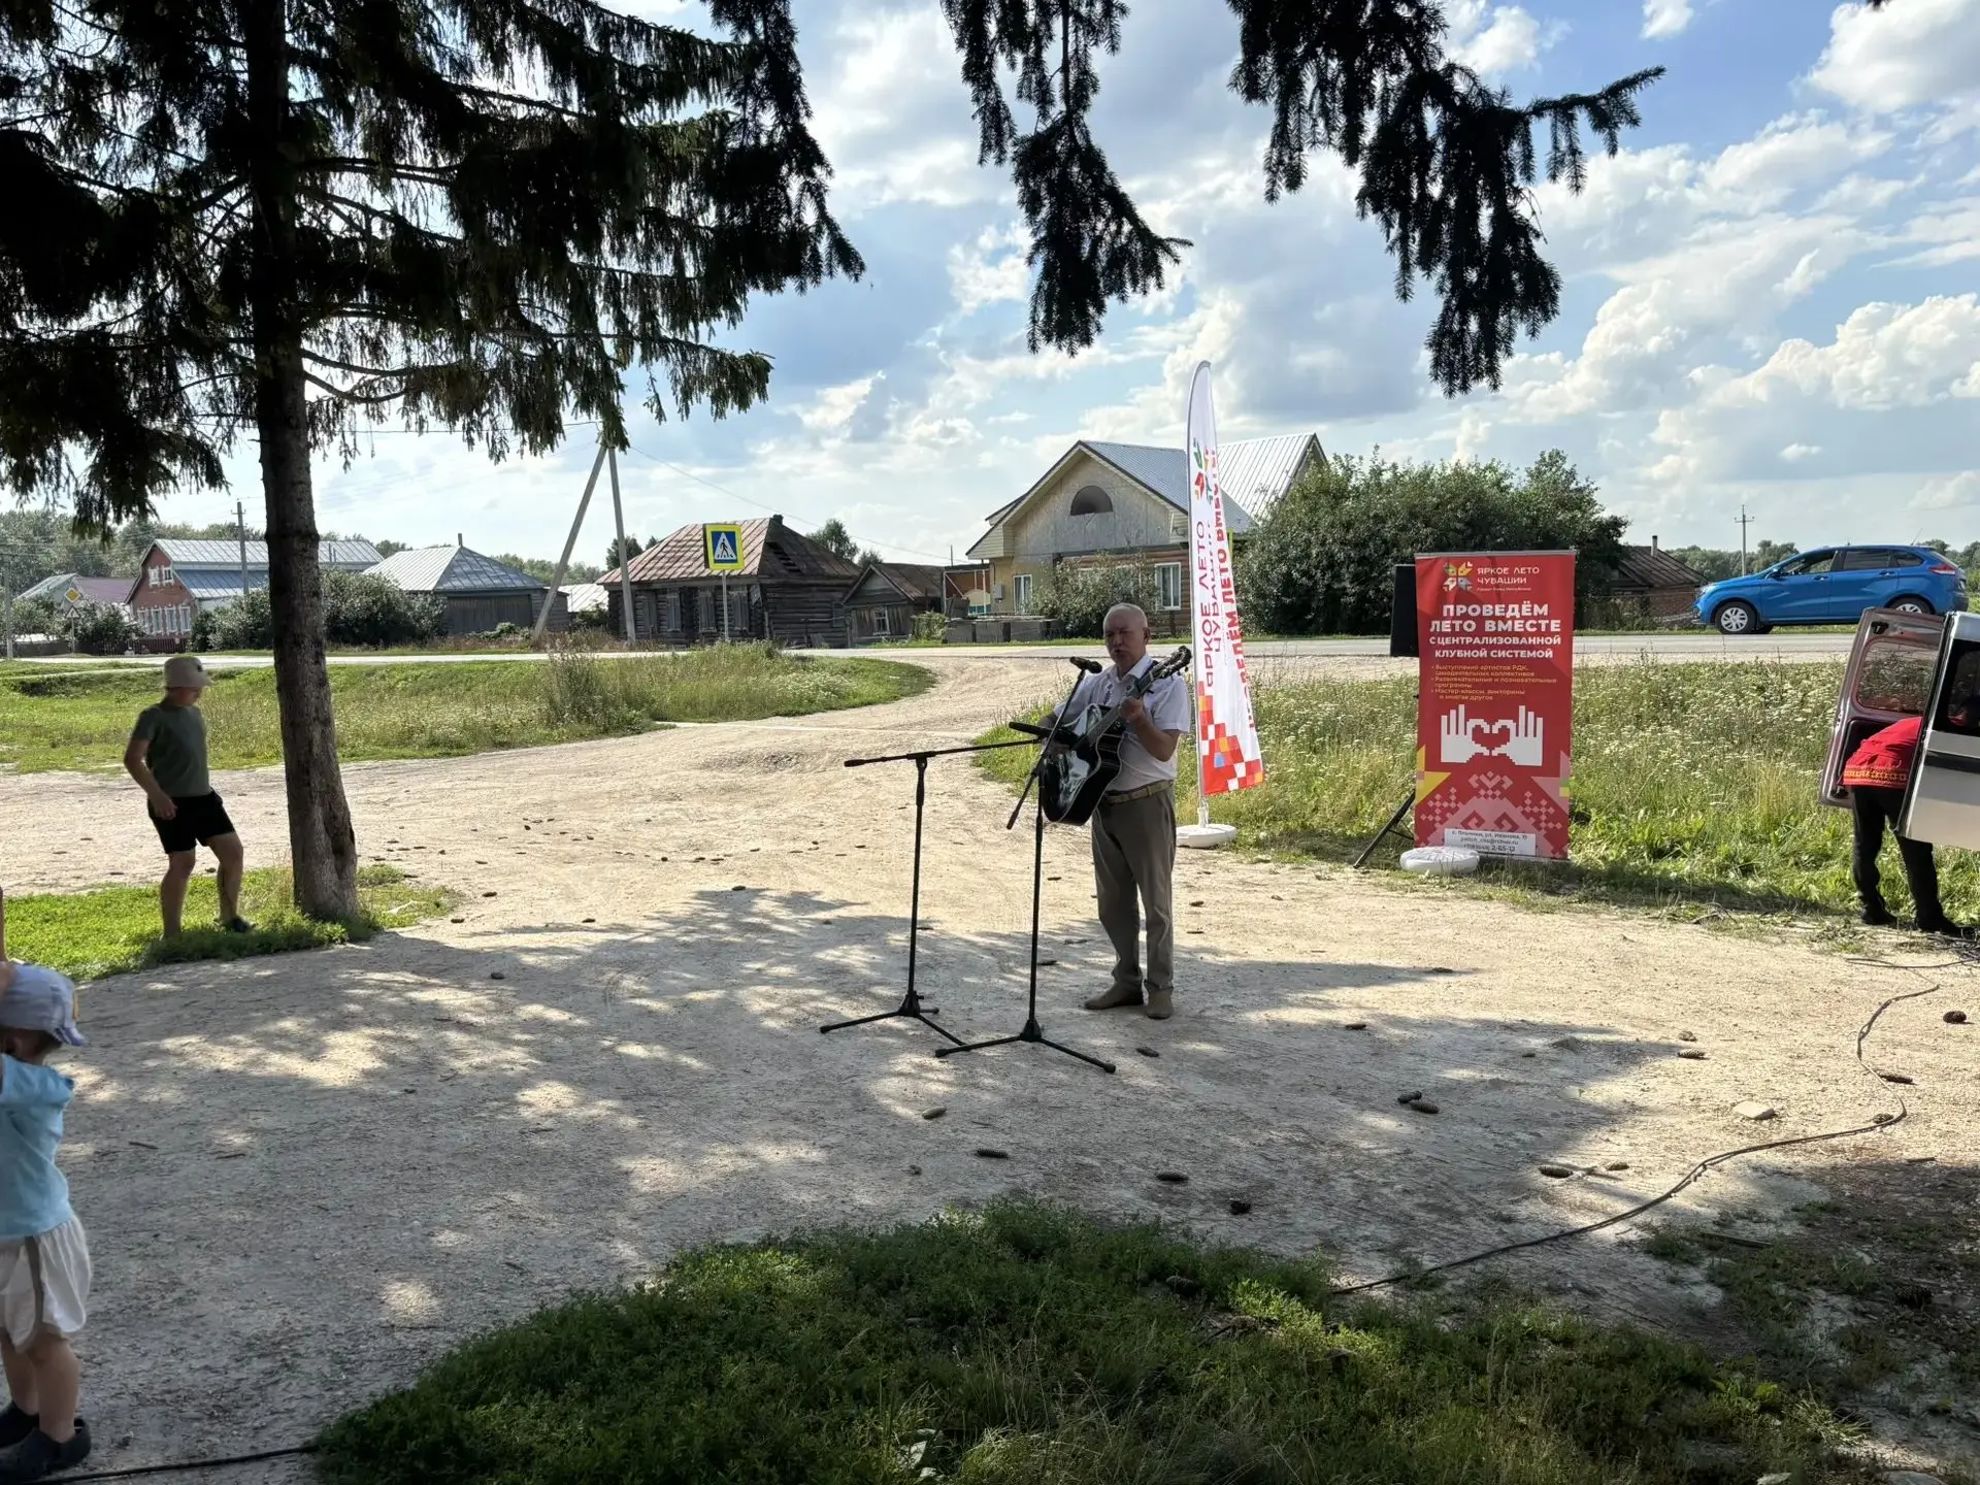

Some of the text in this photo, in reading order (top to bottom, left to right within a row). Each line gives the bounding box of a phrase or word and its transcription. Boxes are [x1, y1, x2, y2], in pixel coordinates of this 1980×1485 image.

[1217, 548, 1235, 604] ЛЕТО
[1477, 566, 1540, 575] ЯРКОЕ ЛЕТО
[1477, 577, 1527, 585] ЧУВАШИИ
[1196, 521, 1213, 687] ЯРКОЕ ЛЕТО
[1442, 601, 1548, 618] ПРОВЕДЁМ
[1430, 620, 1561, 632] ЛЕТО ВМЕСТЕ
[1429, 635, 1561, 646] С ЦЕНТРАЛИЗОВАННОЙ
[1435, 648, 1553, 658] КЛУБНОЙ СИСТЕМОЙ
